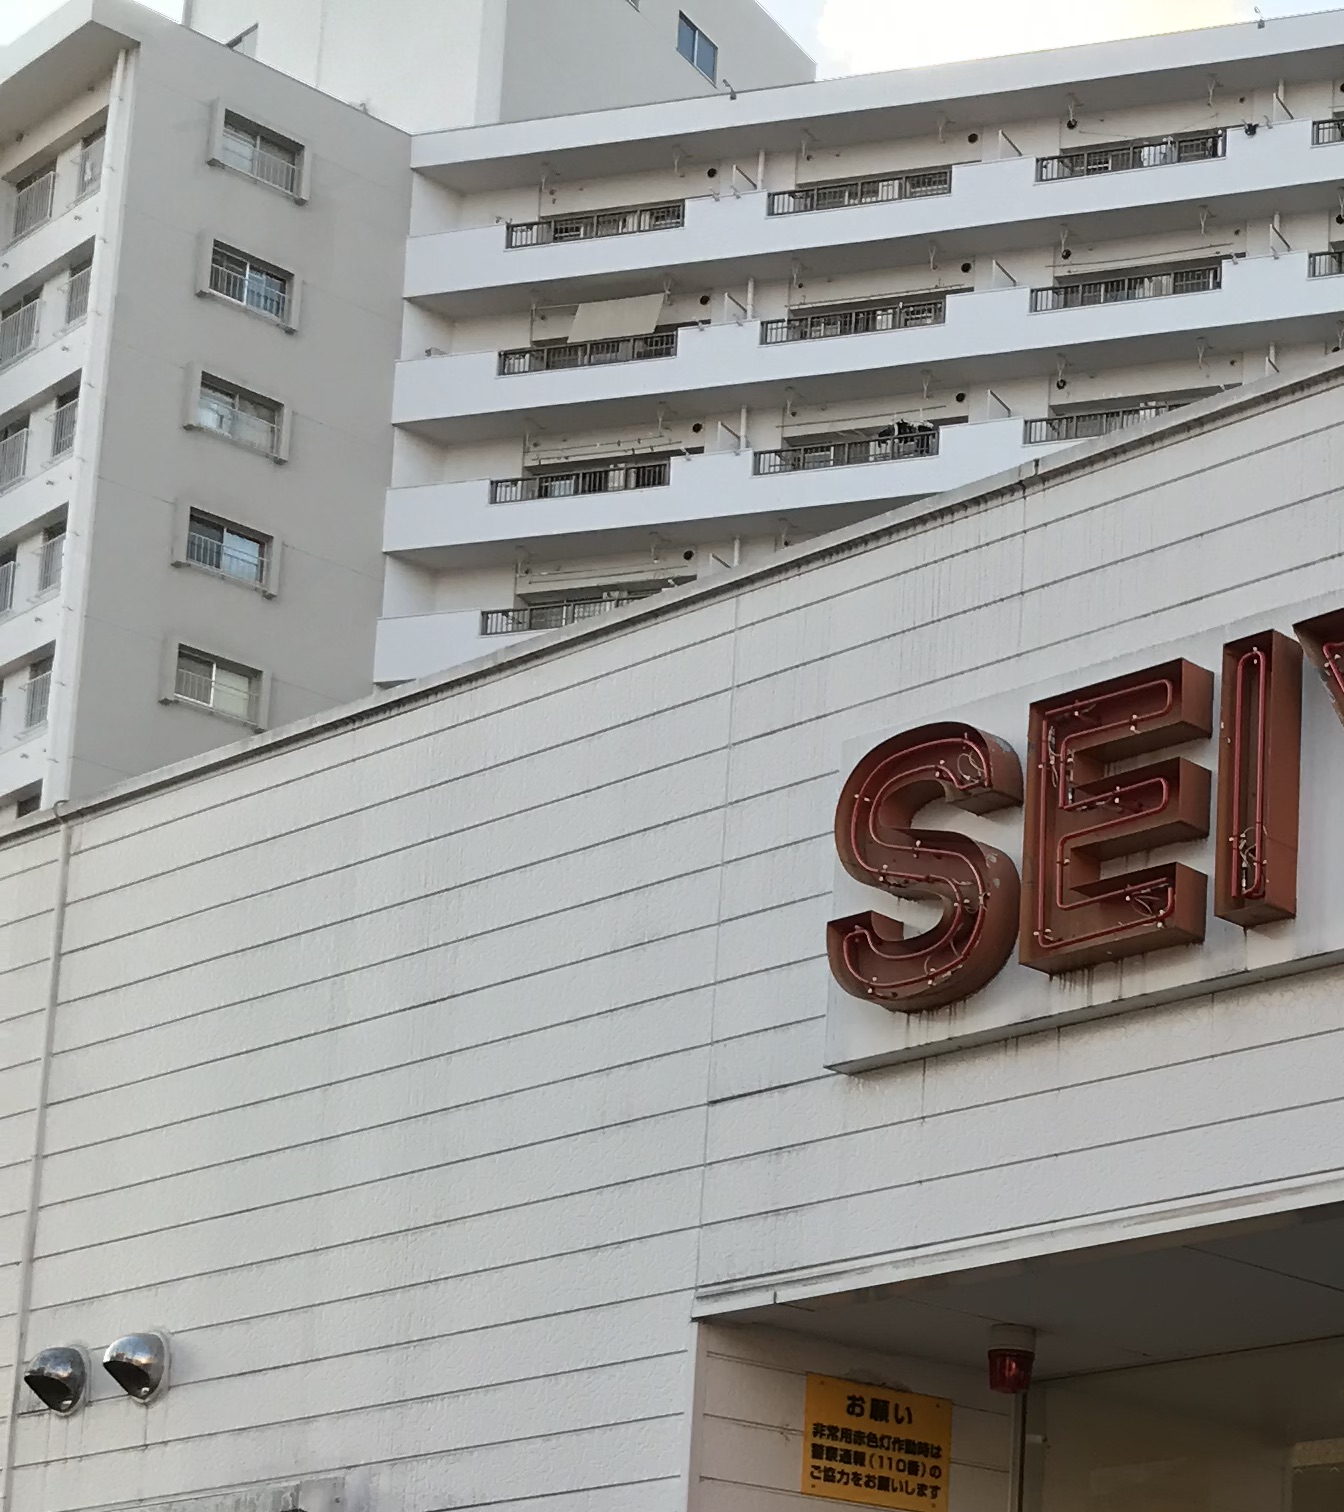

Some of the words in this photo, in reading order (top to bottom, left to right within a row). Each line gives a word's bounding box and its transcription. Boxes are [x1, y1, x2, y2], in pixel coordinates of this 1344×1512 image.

[846, 1395, 913, 1424] お願い
[812, 1423, 942, 1459] 非常用赤色灯作動時は
[810, 1465, 941, 1500] ご協力をお願いします
